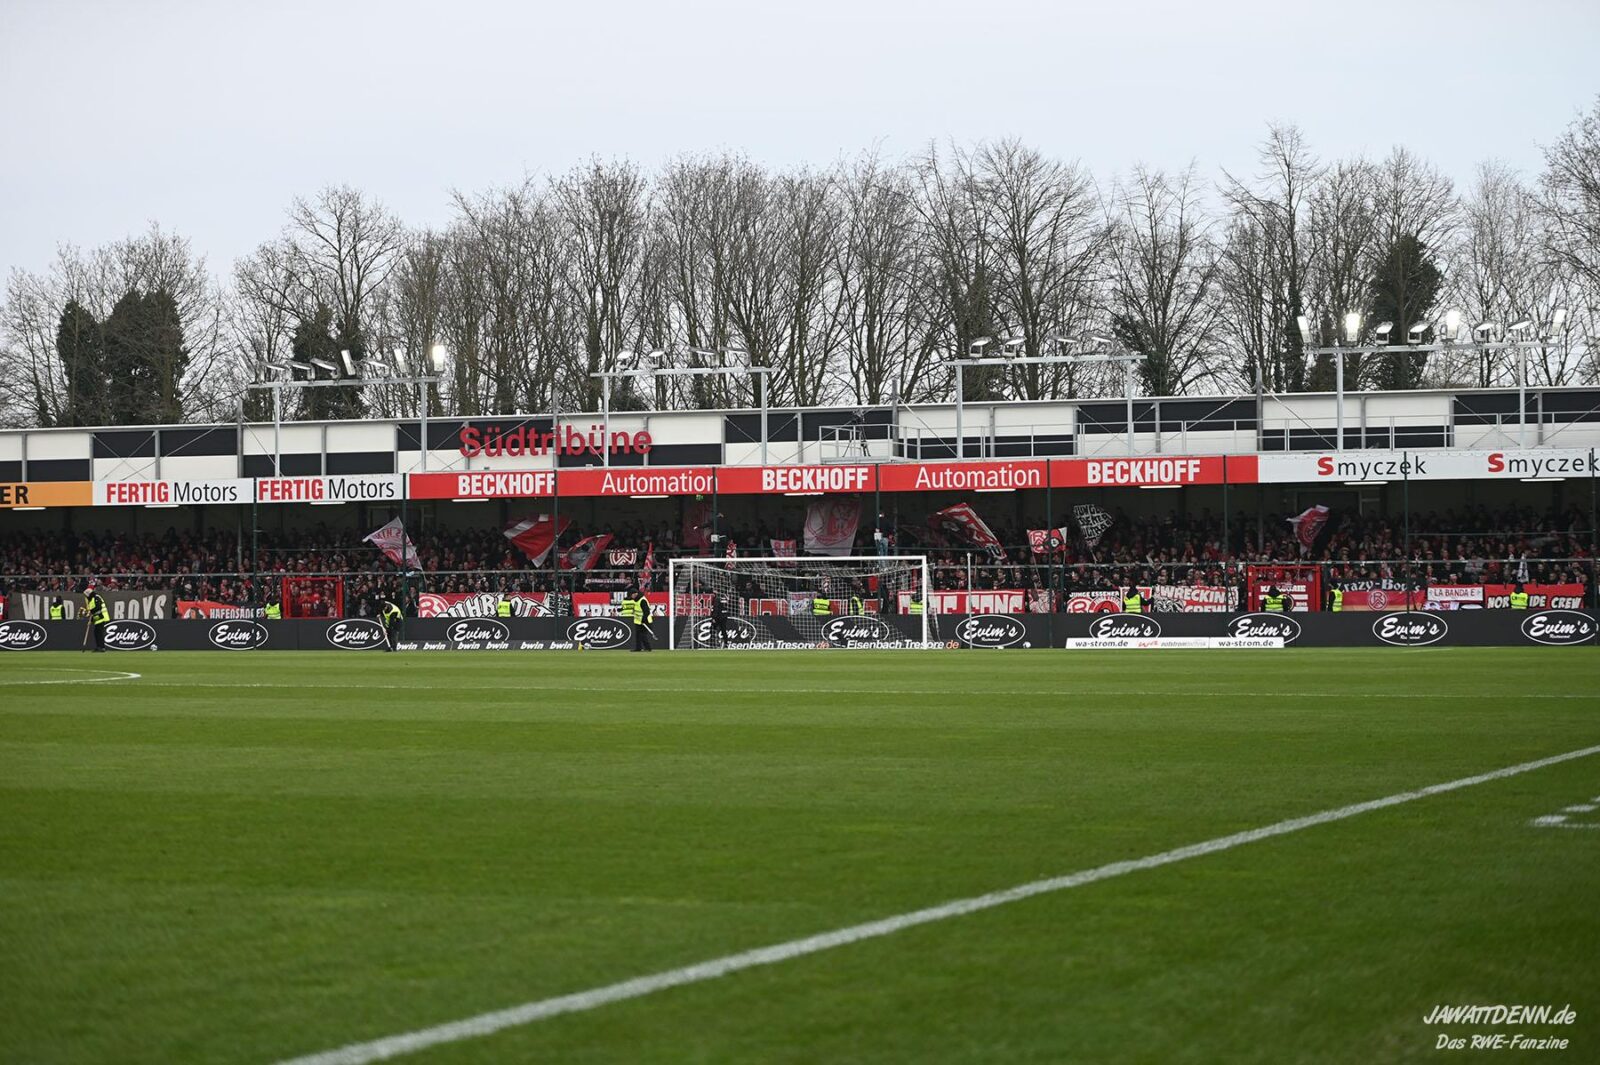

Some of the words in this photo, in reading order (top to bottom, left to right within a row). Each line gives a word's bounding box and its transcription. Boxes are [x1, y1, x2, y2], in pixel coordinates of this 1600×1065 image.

[459, 425, 653, 458] Südtribüne
[1087, 460, 1200, 484] BECKHOFF
[1318, 456, 1427, 480] Smyczek
[1488, 453, 1600, 477] Smyczek
[458, 473, 555, 496] BECKHOFF
[601, 470, 718, 494] Automation
[762, 468, 868, 491] BECKHOFF
[915, 464, 1040, 489] Automation
[0, 485, 29, 504] ER
[106, 482, 169, 503] FERTIG
[174, 482, 237, 502] Motors
[259, 479, 323, 500] FERTIG
[328, 478, 395, 499] Motors
[114, 594, 167, 619] BOYS
[1551, 597, 1582, 609] CREW
[104, 625, 150, 643] Evim's
[333, 624, 380, 643] Evim's
[454, 623, 503, 641] Evim's
[574, 622, 625, 641] Evim's
[963, 620, 1018, 640] Evim's
[1098, 619, 1153, 637] Evim's
[1235, 619, 1292, 637] Evim's
[1530, 616, 1590, 637] Evim's
[423, 641, 446, 650] bwin
[457, 641, 481, 650] bwin
[486, 641, 510, 650] bwin
[520, 641, 544, 650] bwin
[549, 641, 573, 650] bwin
[846, 640, 902, 649] Eisenbach
